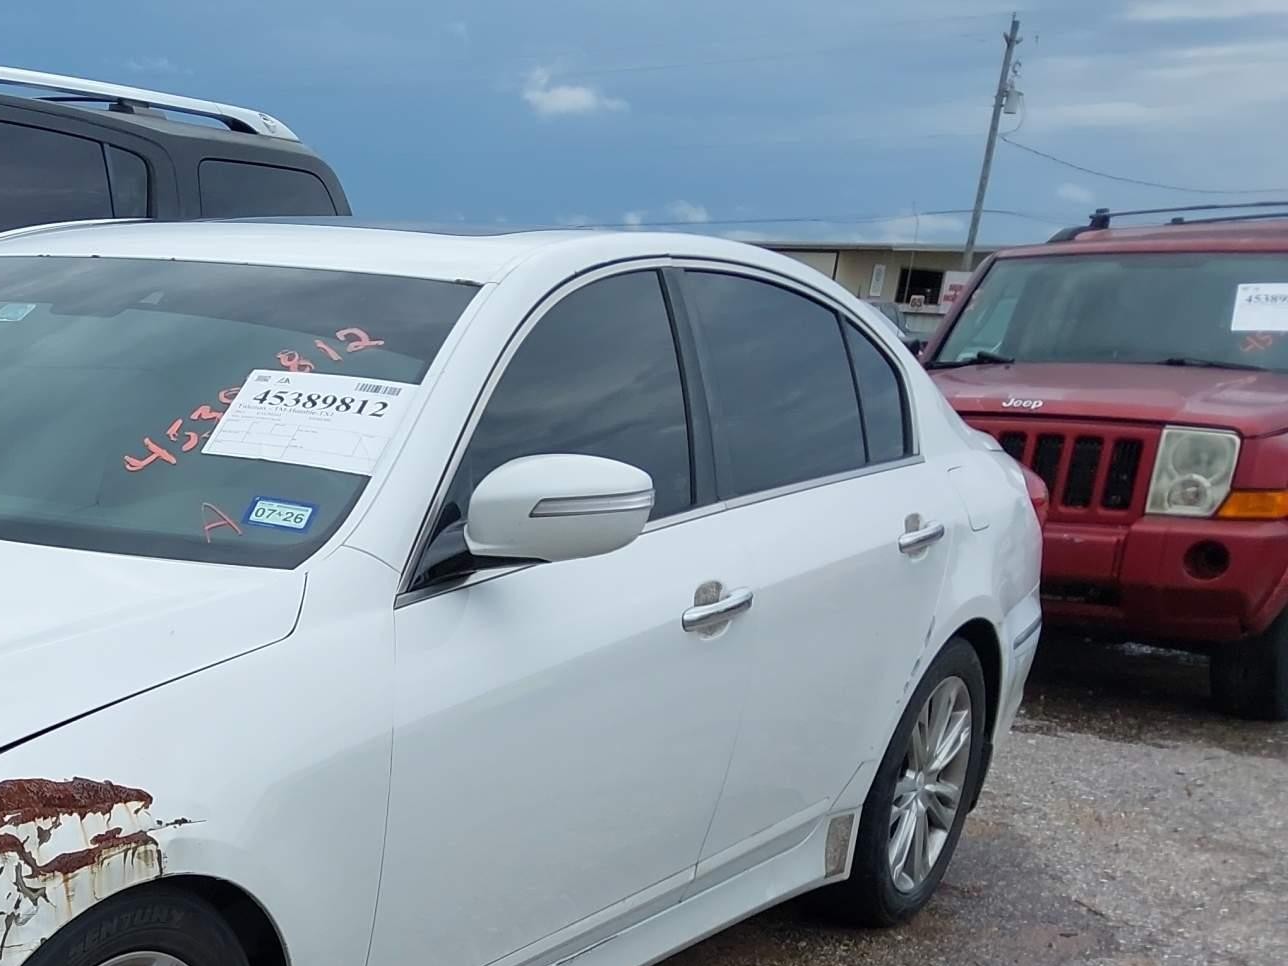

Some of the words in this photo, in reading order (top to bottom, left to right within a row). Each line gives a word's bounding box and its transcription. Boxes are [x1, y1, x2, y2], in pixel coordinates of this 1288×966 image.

[253, 389, 389, 418] 45389812
[1002, 395, 1043, 410] Jeep
[201, 502, 243, 543] A
